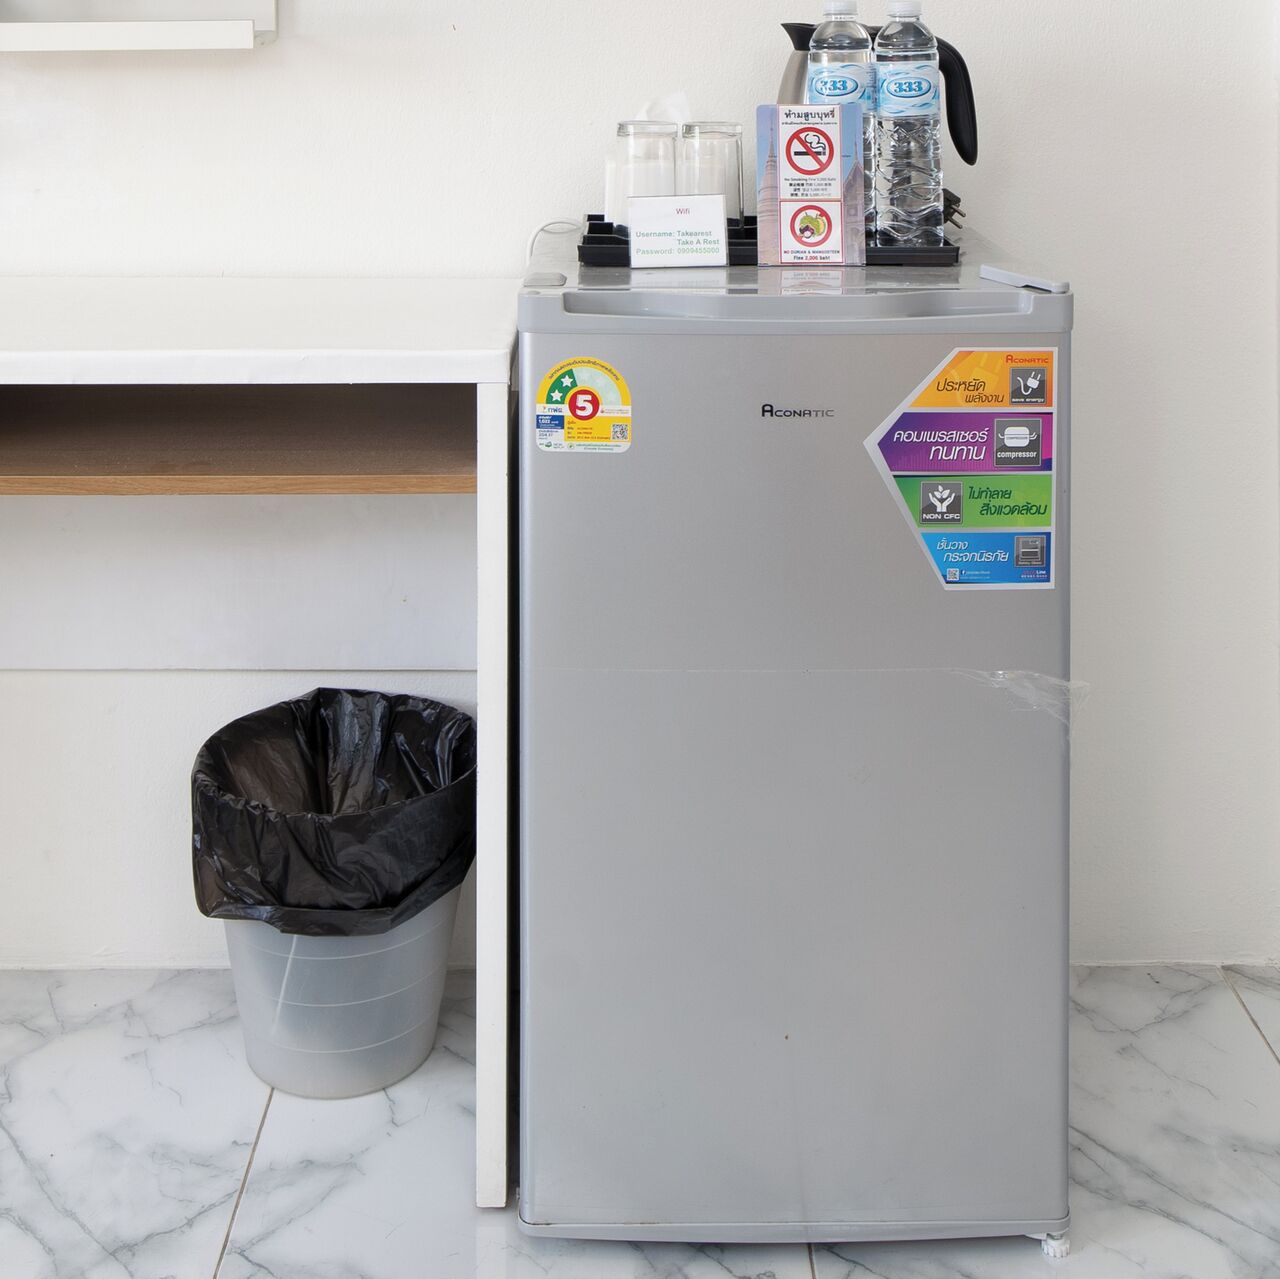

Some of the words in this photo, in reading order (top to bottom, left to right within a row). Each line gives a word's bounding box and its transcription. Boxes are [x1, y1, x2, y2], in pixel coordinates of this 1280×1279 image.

[820, 79, 848, 91] 333
[894, 81, 923, 93] 333
[784, 107, 835, 121] ห้ามสูบบุหรี่
[936, 378, 986, 392] ประหยัด
[965, 392, 1005, 403] พลังงาน
[575, 394, 593, 417] 5
[929, 445, 986, 460] ทนทาน
[997, 451, 1037, 459] compressor
[968, 486, 1012, 500] ไม่ทำลาย
[979, 500, 1048, 516] สิ่งแวดล้อม
[936, 537, 969, 550] ชั้นวาง
[943, 549, 1009, 562] กระจกนิรภัย
